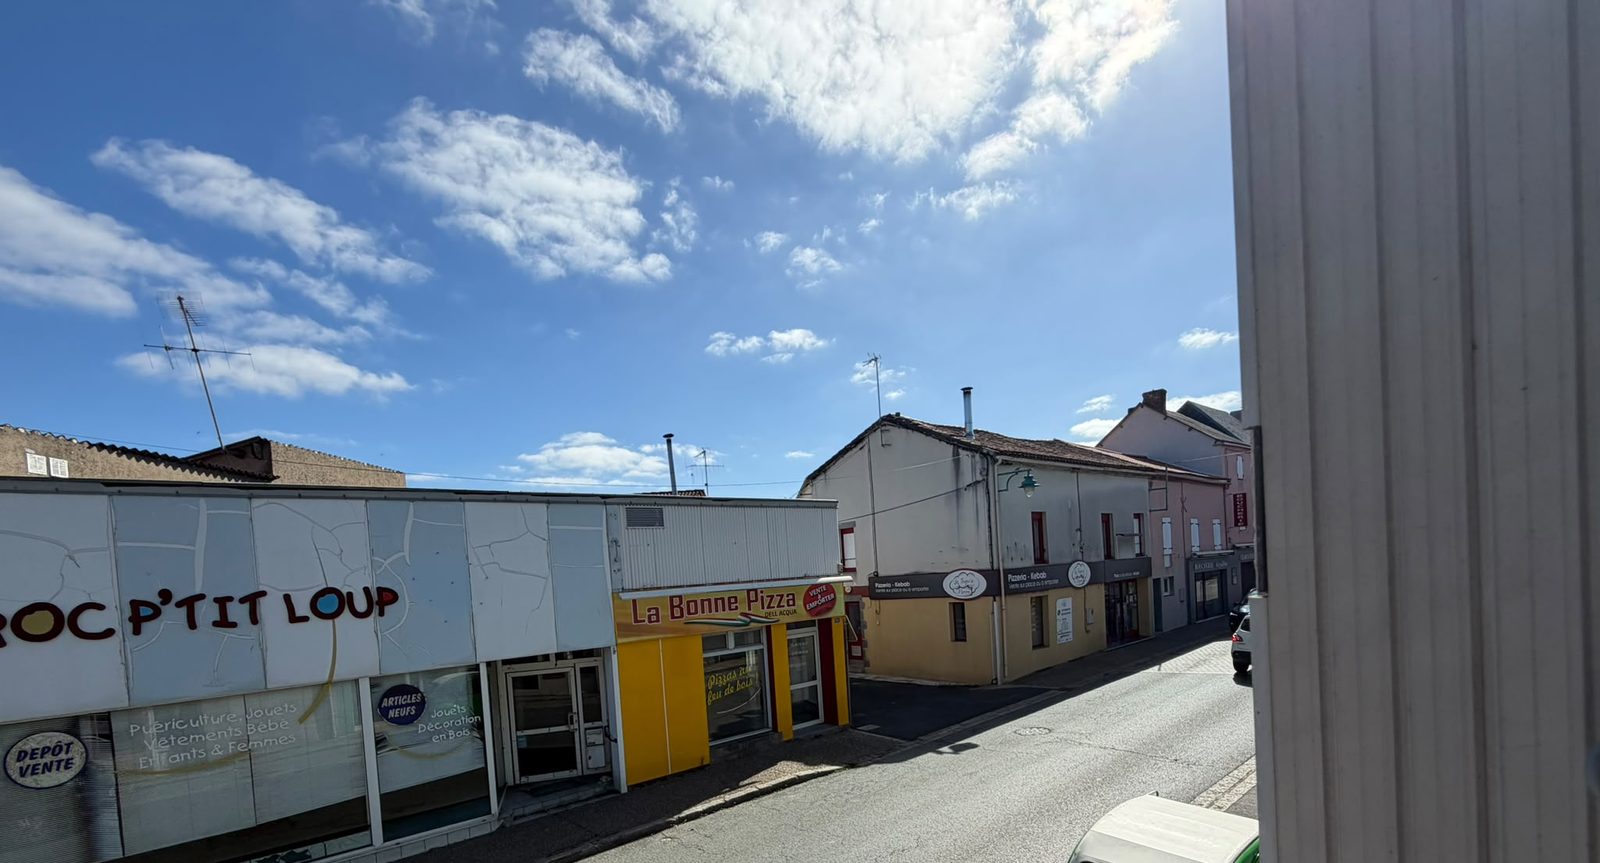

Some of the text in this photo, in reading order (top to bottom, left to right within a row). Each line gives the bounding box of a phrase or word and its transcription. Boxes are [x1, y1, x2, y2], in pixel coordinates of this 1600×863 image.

[1007, 573, 1027, 583] Pizzeria
[1030, 571, 1048, 581] Kebab
[808, 584, 828, 597] VENTE
[632, 589, 797, 625] La Bonne Pizza
[806, 593, 835, 611] EMPORTER
[0, 586, 399, 648] OC P'TIT LOUP
[779, 609, 798, 617] ACQUA
[708, 670, 737, 690] Pizzas
[381, 692, 422, 708] ARTICLES
[708, 678, 753, 706] feu de bois
[246, 703, 297, 720] Jouets
[388, 706, 417, 719] NEUFS
[431, 704, 467, 719] Jouets
[418, 714, 481, 734] Décoration
[144, 719, 289, 751] Vêtements Bébé
[432, 727, 471, 743] en Bois
[16, 740, 74, 763] DEPÔT
[211, 744, 224, 756] &
[228, 736, 296, 754] Femmes
[18, 757, 74, 778] VENTE
